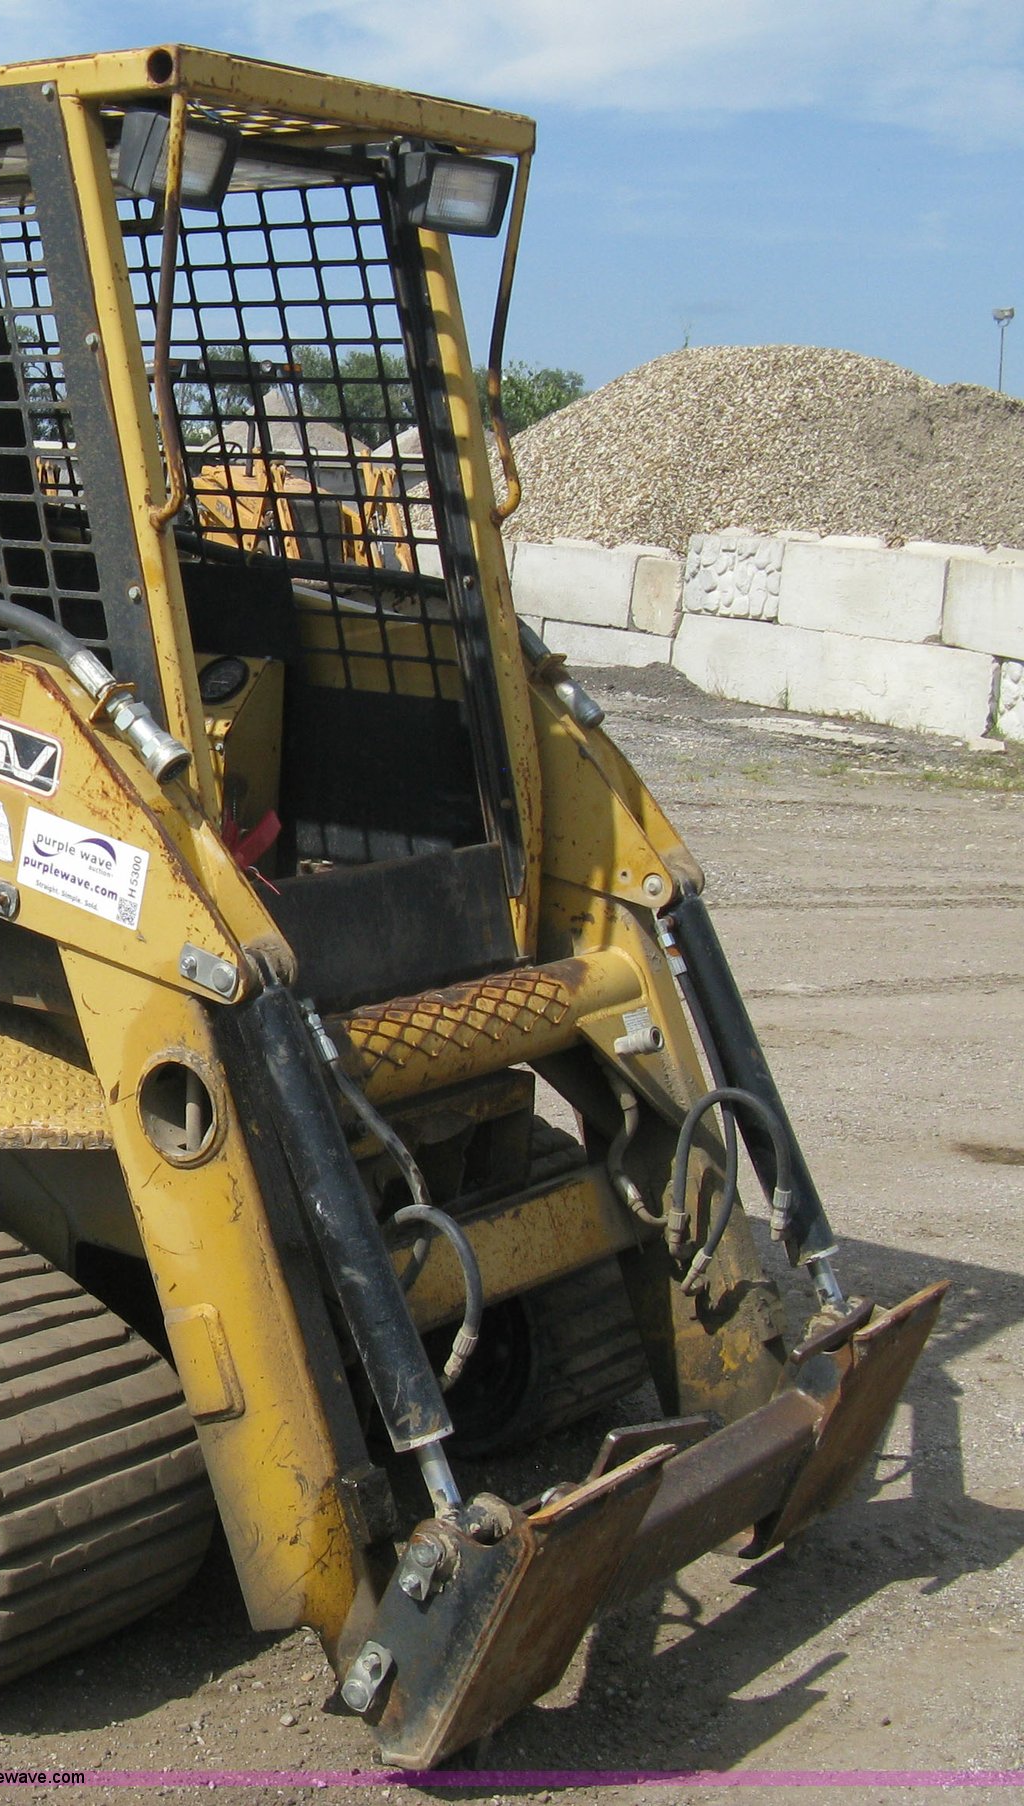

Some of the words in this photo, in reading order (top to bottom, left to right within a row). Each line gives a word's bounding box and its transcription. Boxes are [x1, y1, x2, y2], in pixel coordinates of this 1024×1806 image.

[36, 833, 76, 856] purple
[80, 850, 112, 870] wave
[23, 856, 118, 901] purplewave.com
[130, 855, 143, 887] 5300
[128, 888, 137, 899] H
